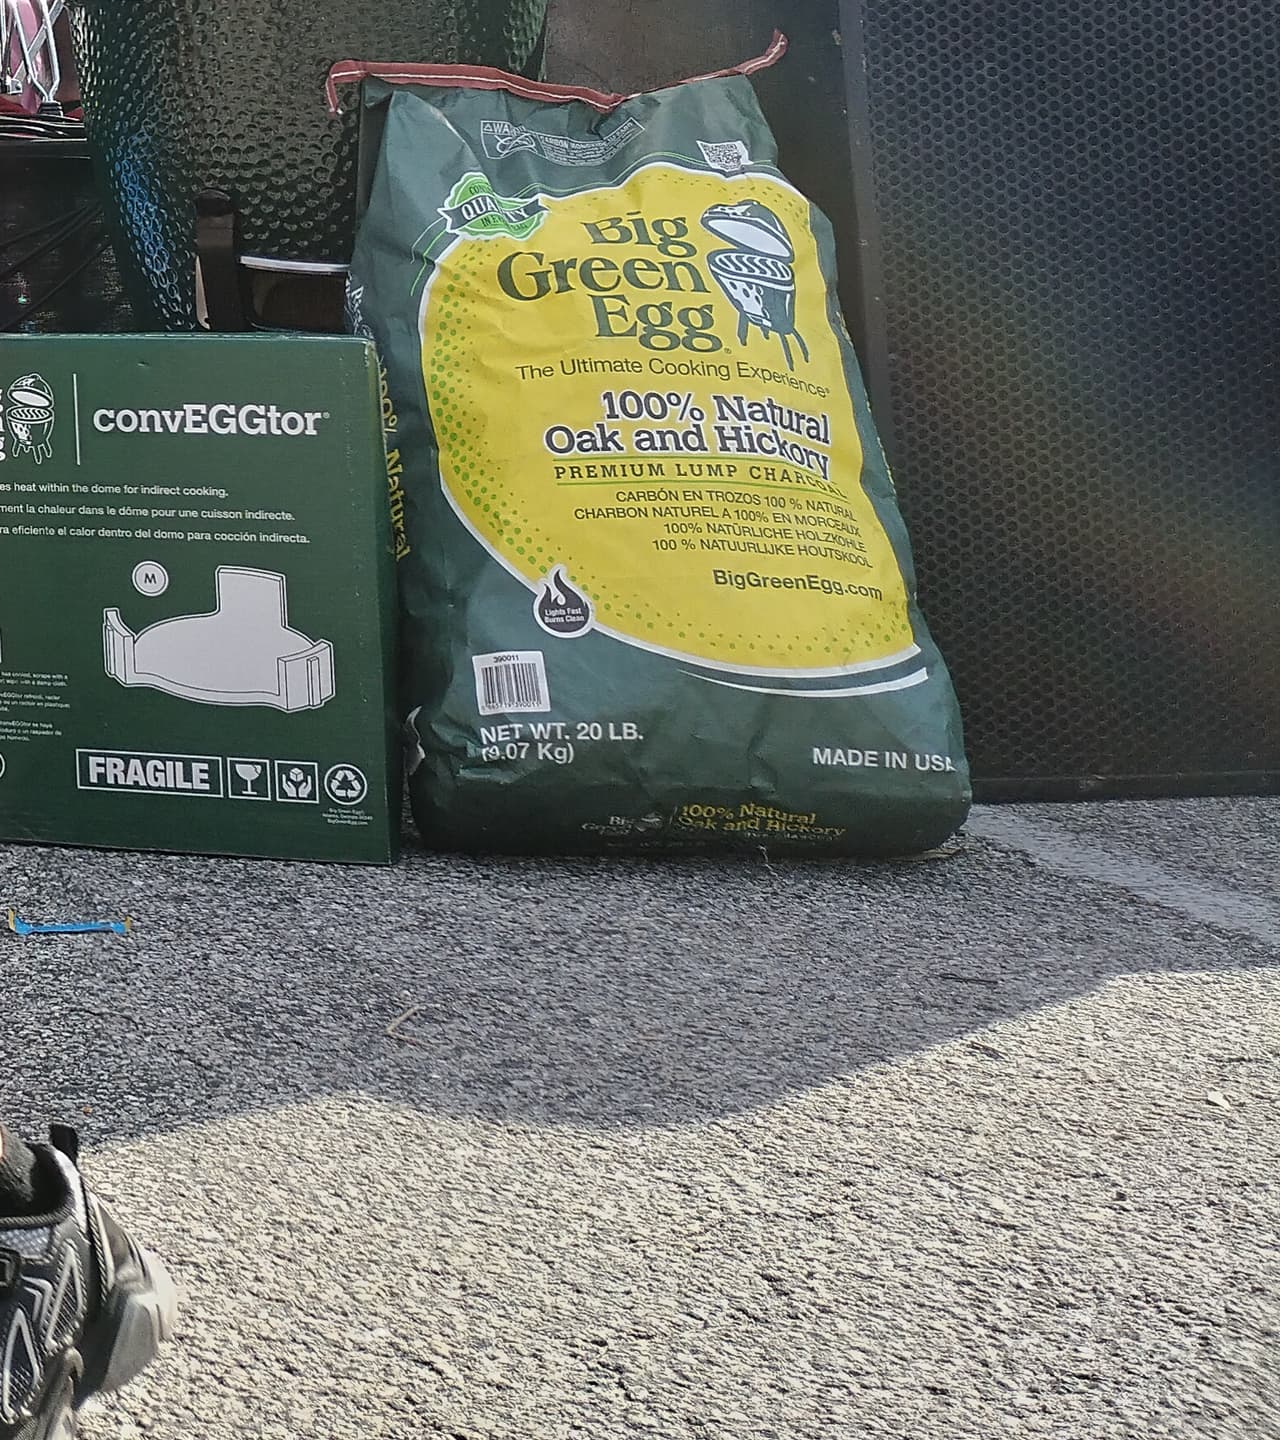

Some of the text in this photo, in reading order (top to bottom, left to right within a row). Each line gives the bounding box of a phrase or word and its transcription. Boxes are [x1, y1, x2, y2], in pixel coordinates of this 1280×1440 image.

[580, 210, 698, 258] Big
[497, 251, 711, 301] Green
[587, 293, 723, 354] Egg
[515, 357, 827, 398] The Ultimate Cooking Experience
[93, 403, 323, 436] convEGGtor
[602, 390, 831, 446] 100% Natural
[544, 423, 830, 482] Oak and Hickory
[14, 482, 37, 492] heat
[39, 483, 70, 493] within
[72, 484, 89, 493] the
[91, 484, 121, 494] dome
[123, 484, 138, 494] for
[140, 484, 181, 496] indirect
[183, 486, 229, 498] cooking.
[554, 463, 848, 500] PREMIUM LUMP CHARCOAL
[26, 503, 35, 514] la
[38, 504, 75, 515] chaleur
[78, 505, 104, 515] dans
[106, 506, 116, 516] le
[151, 509, 176, 519] pour
[178, 509, 199, 518] une
[201, 508, 242, 520] cuisson
[245, 510, 296, 521] indirecte.
[386, 448, 412, 562] Natural
[616, 487, 858, 522] CARBÓN EN TROZOS 100 % NATURAL
[12, 525, 55, 536] eficiente
[57, 526, 66, 536] el
[69, 526, 96, 537] calor
[98, 527, 132, 538] dentro
[134, 528, 151, 539] del
[153, 529, 184, 540] domo
[187, 531, 211, 542] para
[214, 531, 257, 542] cocción
[259, 532, 310, 544] indirecta.
[574, 508, 649, 520] CHARBON
[652, 507, 720, 520] NATUREL
[735, 509, 769, 524] 100%
[772, 512, 792, 525] EN
[794, 514, 862, 538] MORCEAUX
[663, 522, 703, 535] 100%
[796, 528, 867, 553] HOLZKOHLE
[651, 538, 874, 569] 100 % NATUURLIJKE HOUTSKOOL
[143, 573, 157, 585] M
[712, 568, 884, 602] BigGreenEgg.com
[544, 607, 582, 617] Lights Fast
[544, 614, 585, 623] Burns Clean
[493, 654, 520, 664] 390011
[480, 722, 644, 745] NET WT. 20 LB.
[481, 742, 575, 764] (9.07 Kg)
[812, 747, 878, 768] MADE
[885, 751, 907, 770] IN
[88, 755, 210, 791] FRAGILE
[681, 801, 816, 824] 100% Natural
[722, 817, 760, 832] and
[766, 818, 848, 839] Hickory
